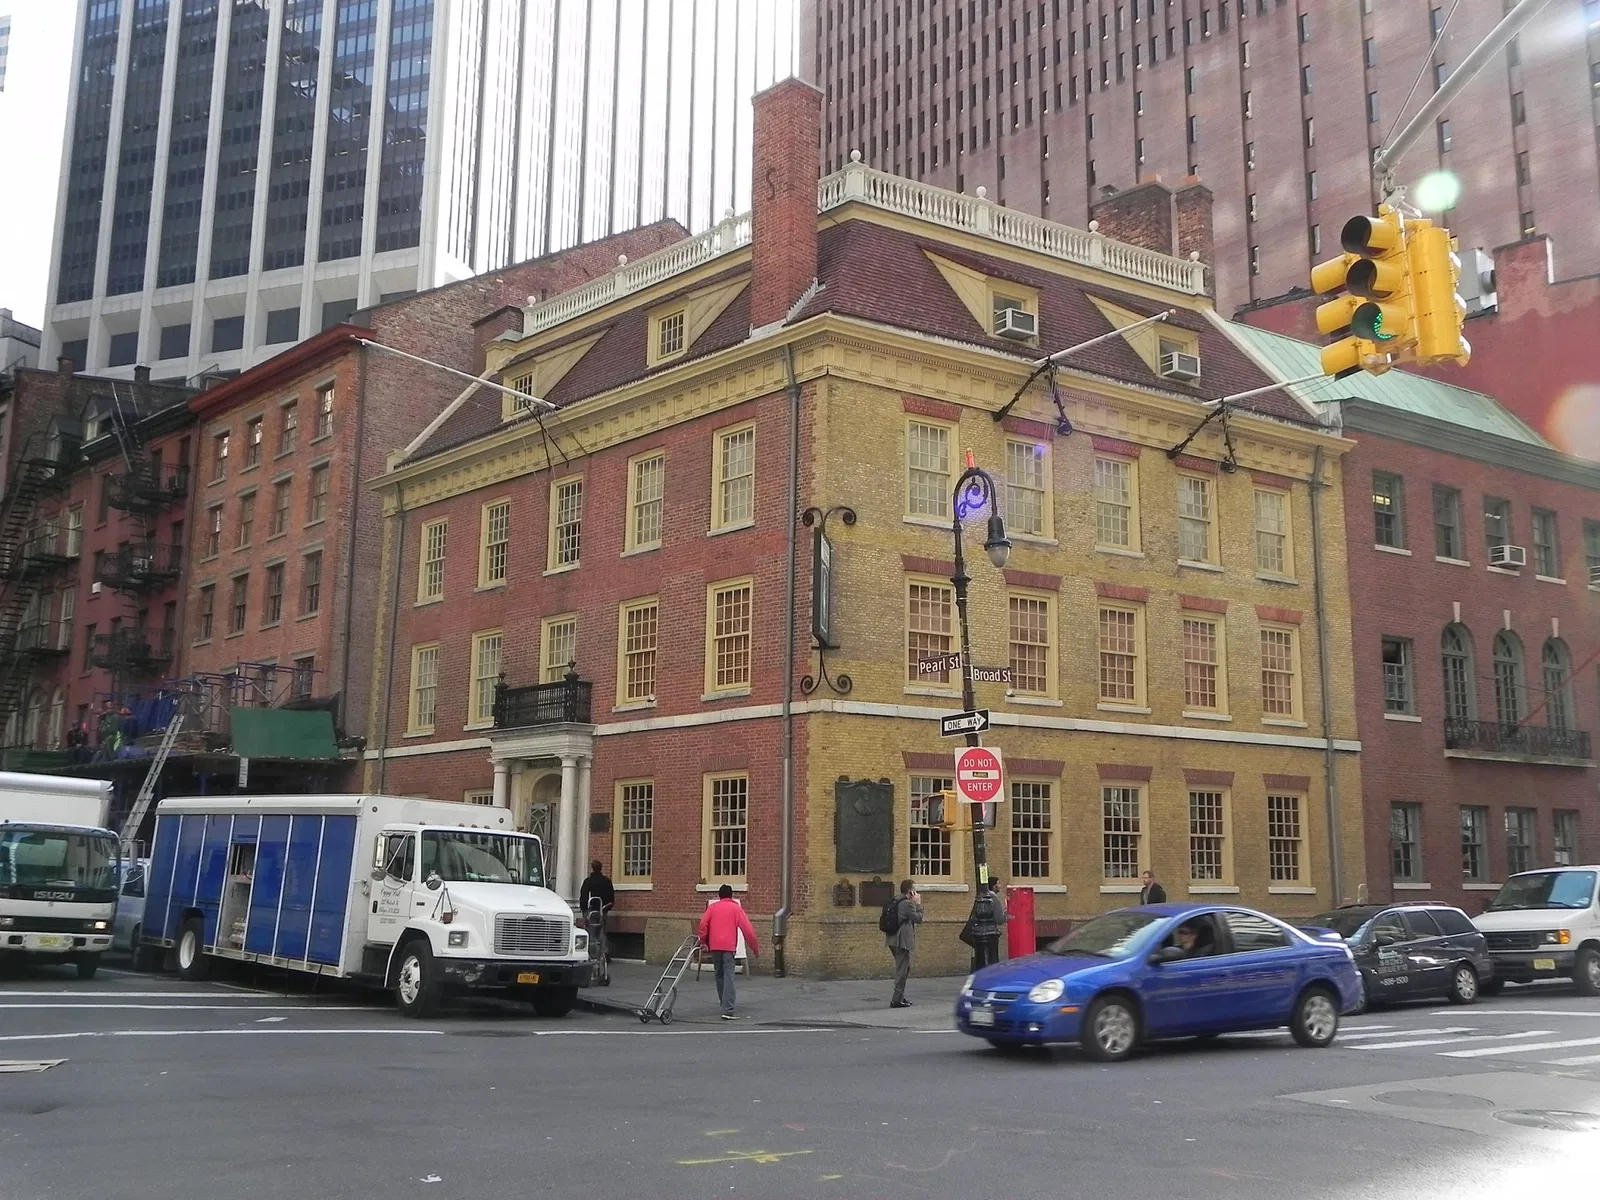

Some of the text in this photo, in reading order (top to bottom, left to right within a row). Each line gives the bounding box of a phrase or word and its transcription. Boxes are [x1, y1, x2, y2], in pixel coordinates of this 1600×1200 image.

[920, 656, 960, 674] Pearl St
[974, 668, 1012, 682] Broad St
[947, 717, 982, 730] ONE WAY
[964, 758, 993, 768] DO NOT
[967, 782, 993, 792] ENTER
[33, 891, 75, 900] ISUZU
